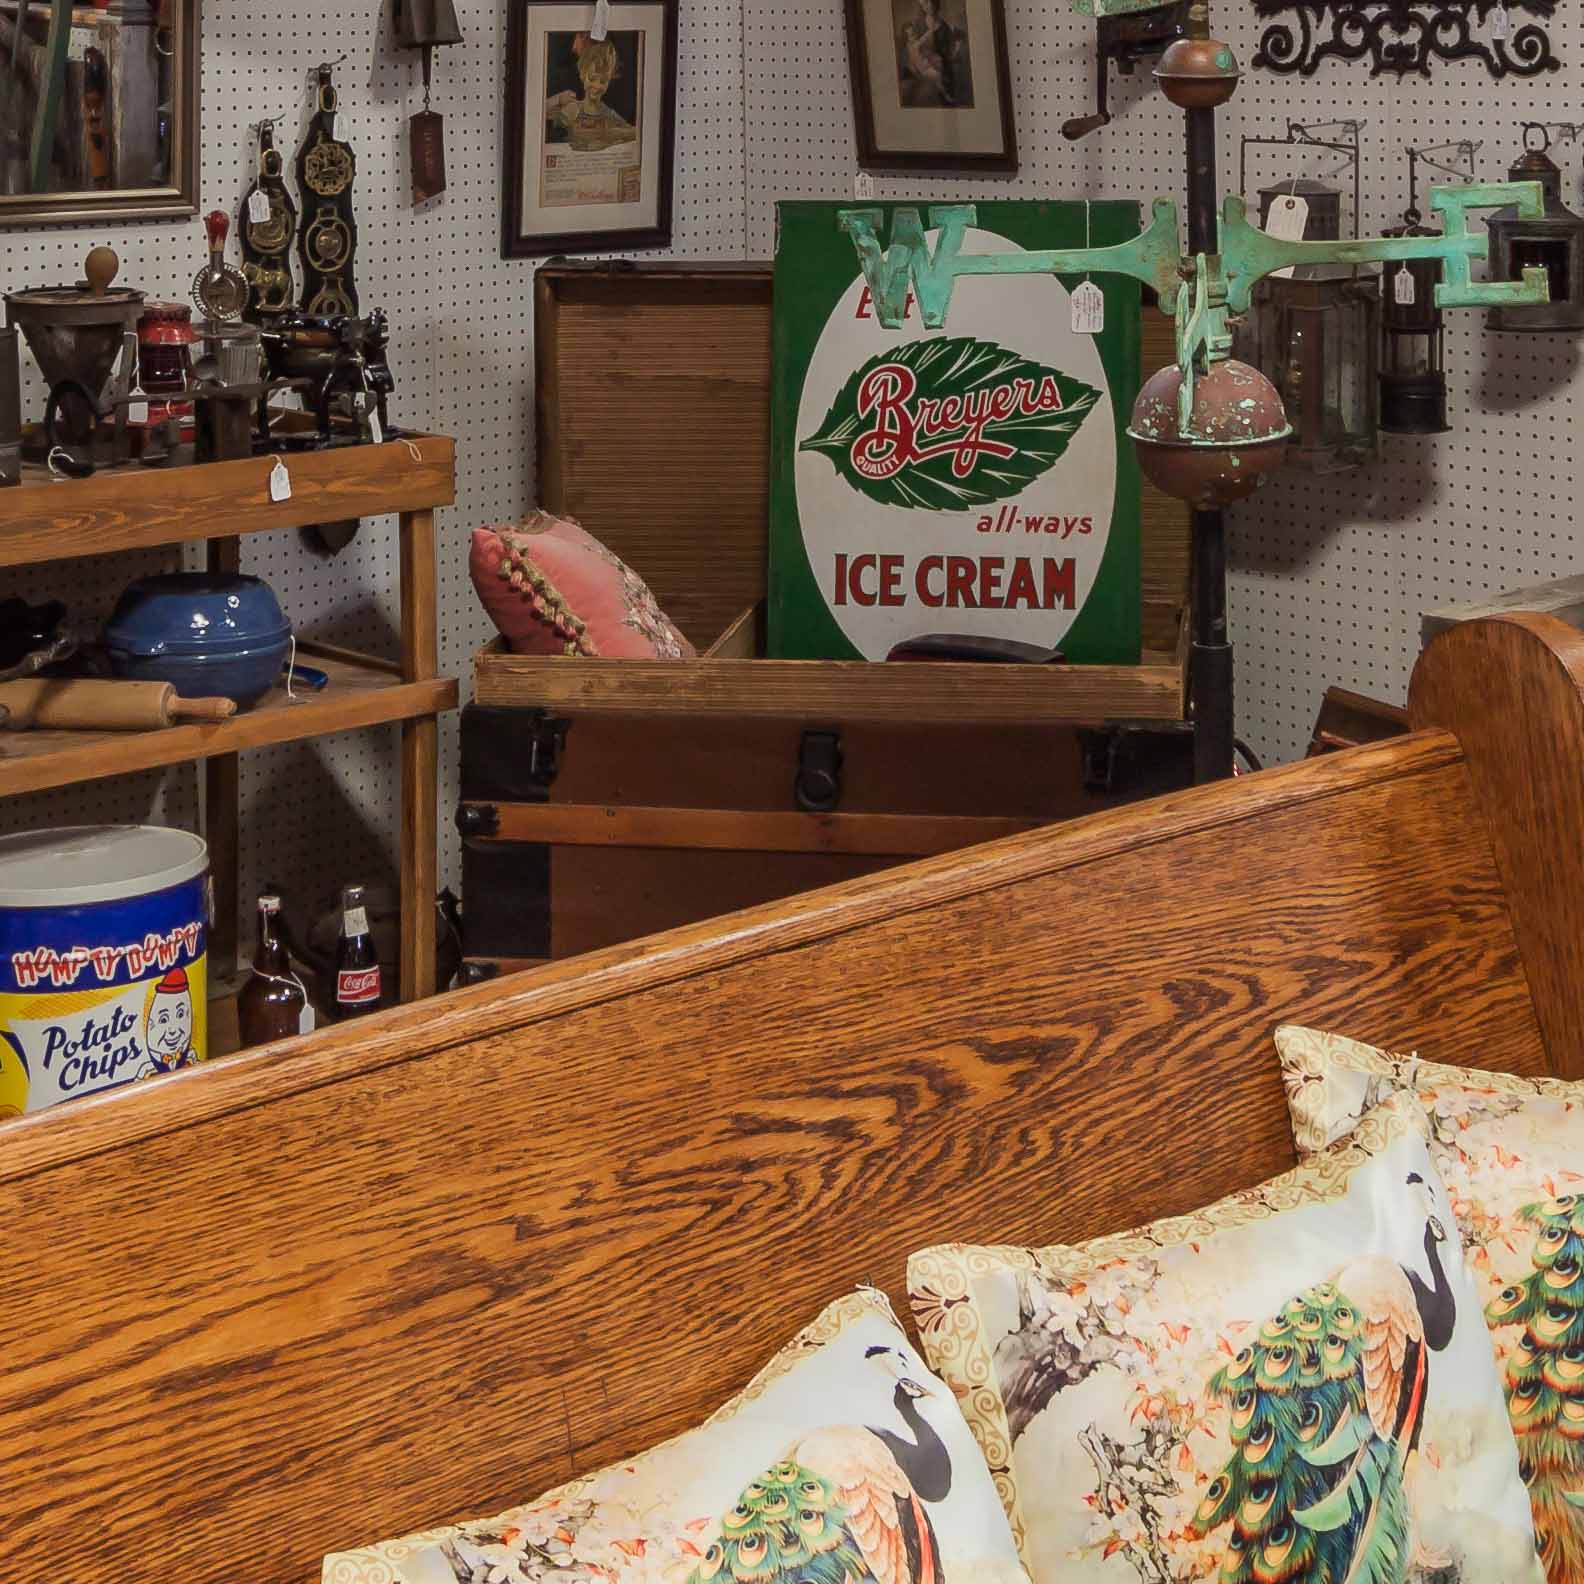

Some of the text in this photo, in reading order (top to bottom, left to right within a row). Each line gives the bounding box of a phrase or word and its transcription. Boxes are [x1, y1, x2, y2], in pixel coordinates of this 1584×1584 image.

[855, 285, 916, 320] Et
[850, 362, 1064, 478] Breyers
[856, 454, 900, 476] QUALITY
[976, 504, 1093, 540] all-ways
[833, 553, 1077, 611] ICE CREAM
[12, 922, 202, 987] HUMPTY DUMPTY
[42, 1004, 139, 1070] Potato
[58, 1036, 144, 1092] Chips
